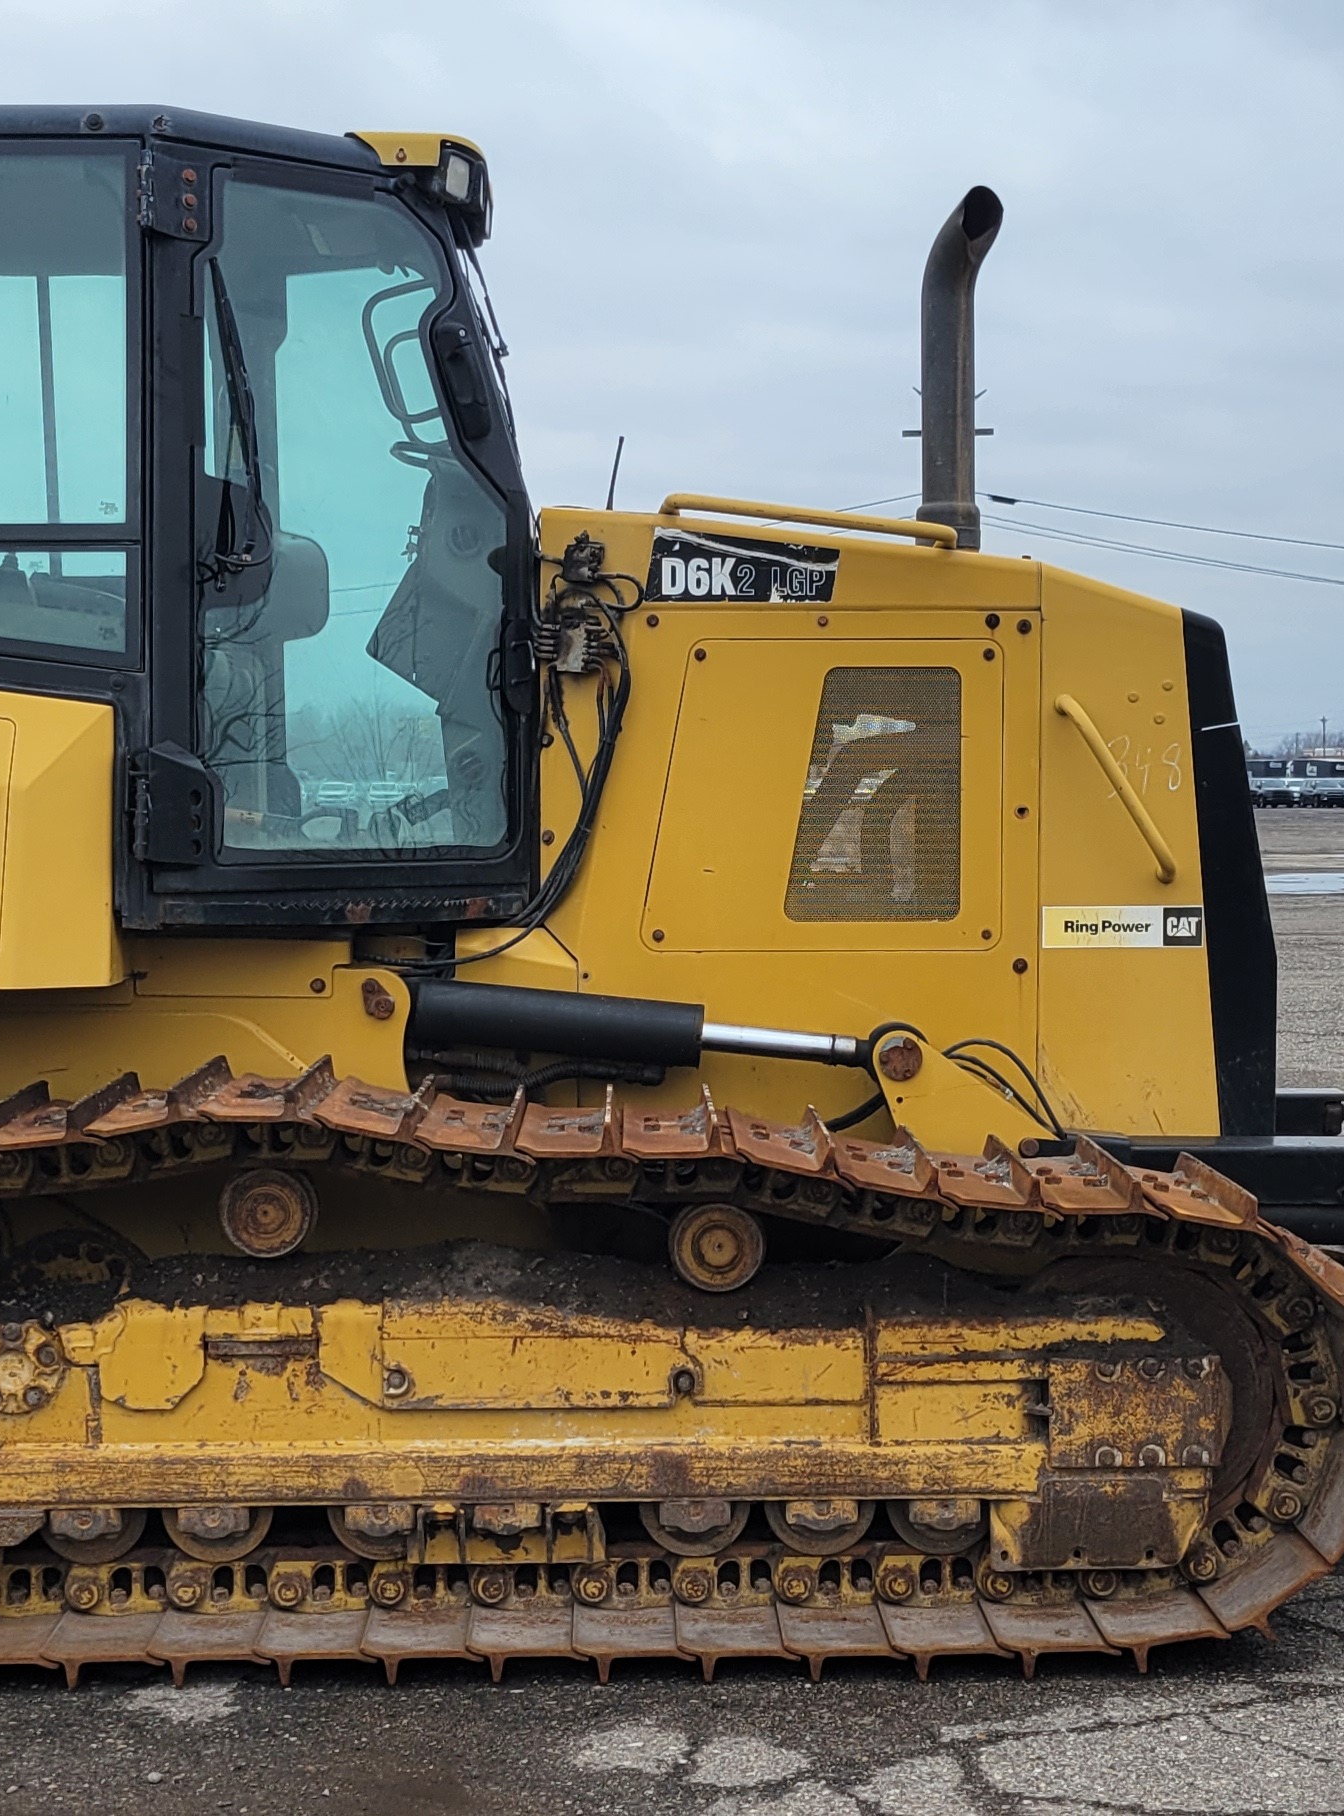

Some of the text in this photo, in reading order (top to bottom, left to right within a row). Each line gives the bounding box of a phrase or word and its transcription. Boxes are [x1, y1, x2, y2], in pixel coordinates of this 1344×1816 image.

[771, 566, 826, 597] LGP
[1064, 920, 1152, 935] Ring Power
[1166, 916, 1199, 937] CAT
